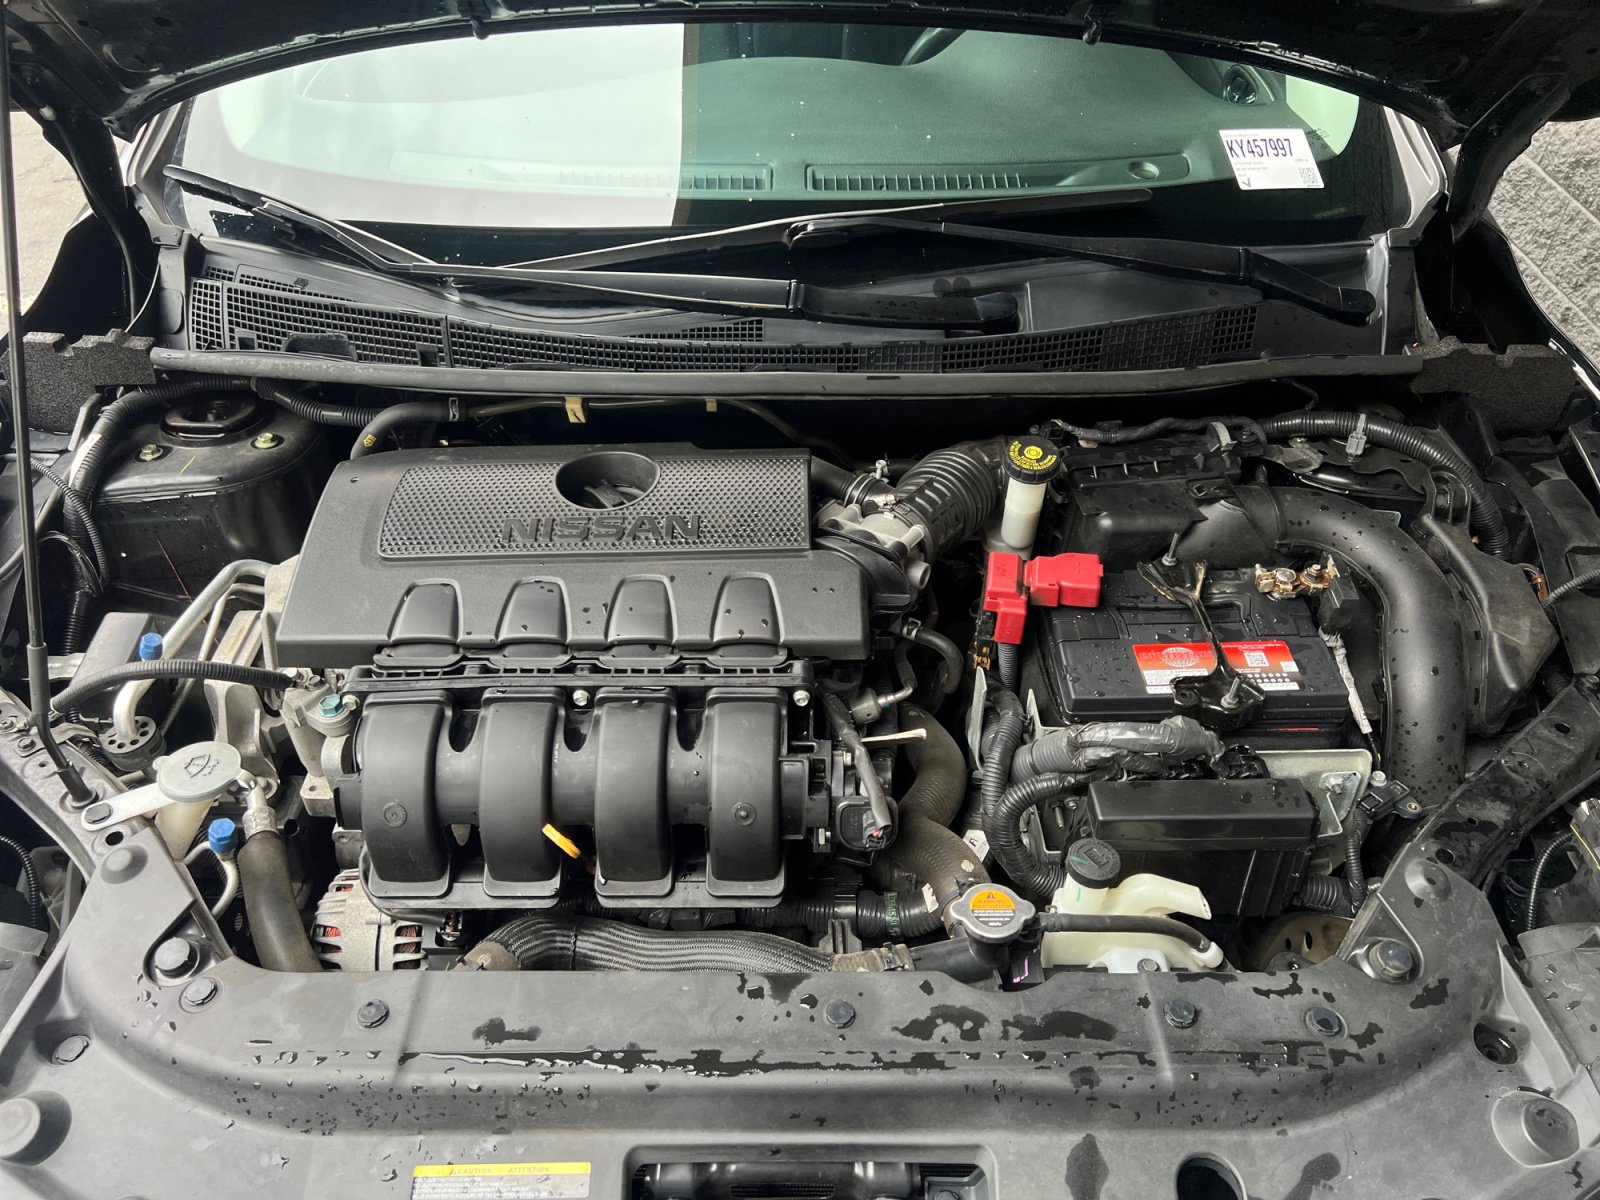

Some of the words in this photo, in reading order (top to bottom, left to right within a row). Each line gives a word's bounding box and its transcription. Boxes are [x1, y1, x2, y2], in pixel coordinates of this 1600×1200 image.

[1226, 138, 1293, 158] KY457997
[503, 515, 700, 541] NISSAN
[508, 1165, 550, 1173] ATTENTION
